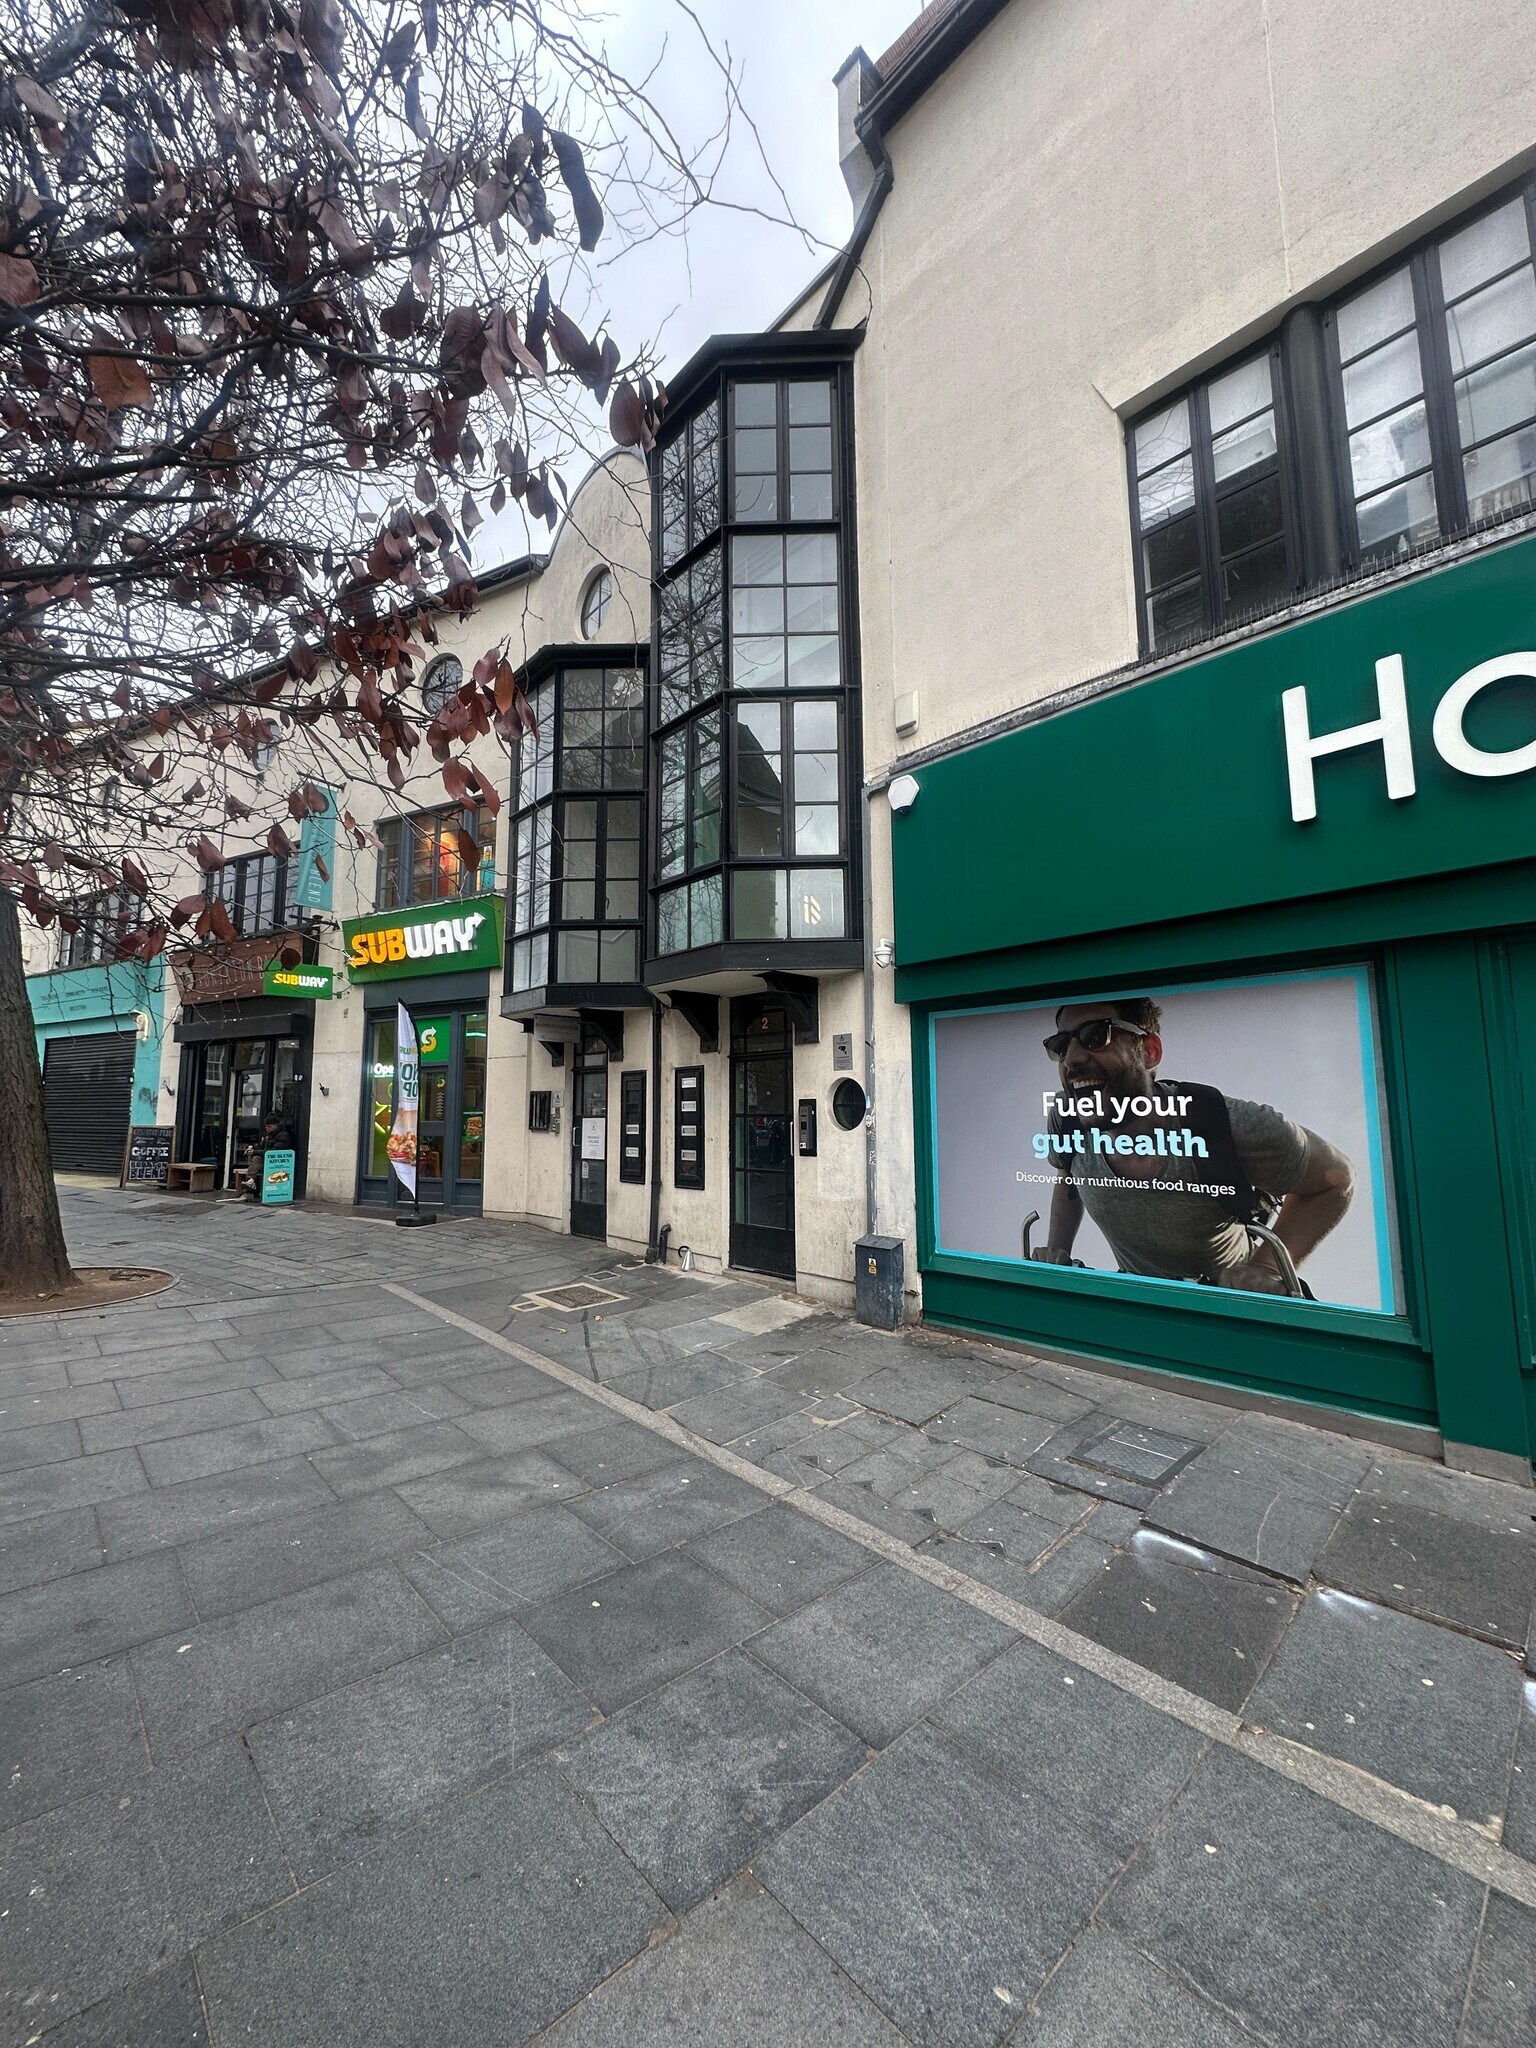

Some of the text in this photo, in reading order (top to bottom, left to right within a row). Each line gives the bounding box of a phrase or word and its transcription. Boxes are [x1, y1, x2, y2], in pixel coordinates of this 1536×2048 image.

[1282, 651, 1536, 823] HO
[348, 912, 486, 969] SUBWAY
[273, 973, 328, 988] SUBWAY
[761, 1017, 768, 1030] 2
[374, 1062, 394, 1076] Ope
[1042, 1090, 1193, 1123] Fuel your
[131, 1146, 169, 1156] COFFEE
[1032, 1128, 1209, 1159] gut health
[129, 1168, 167, 1180] BLEND
[1016, 1171, 1236, 1197] Discover our nutritious food ranges
